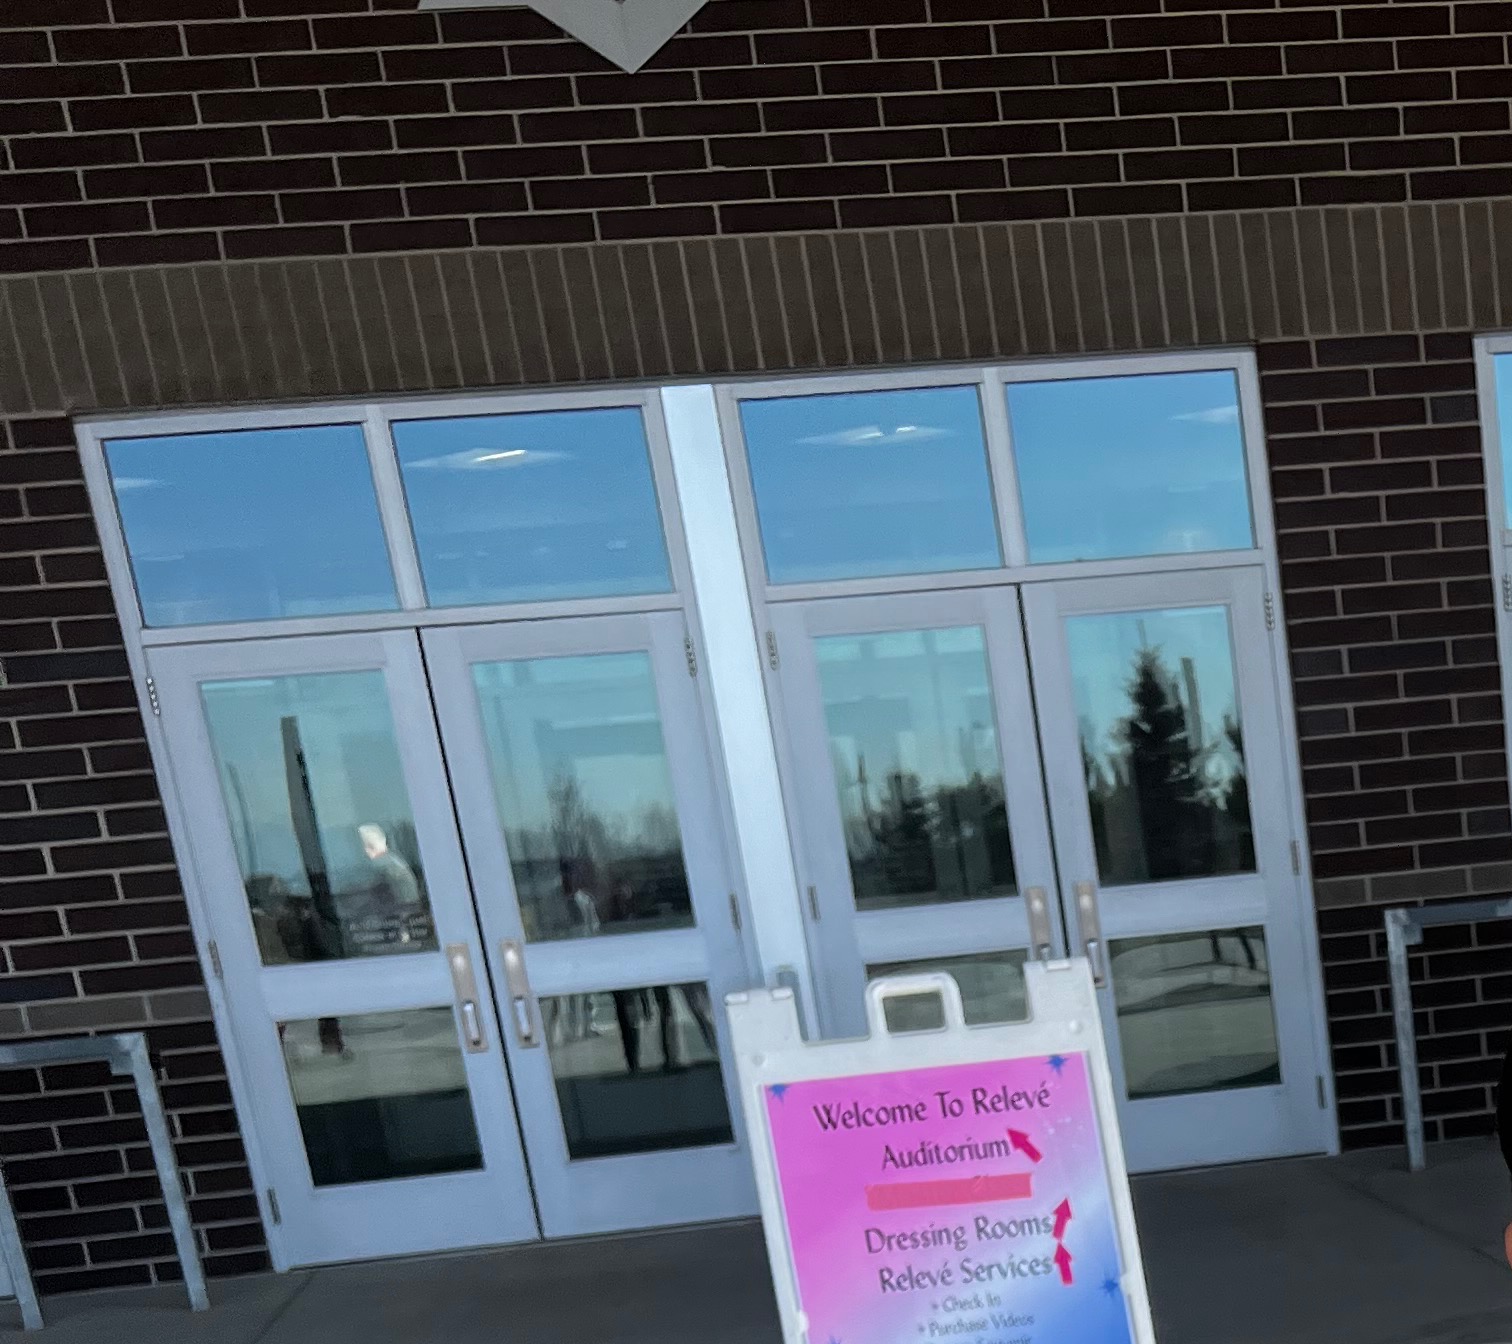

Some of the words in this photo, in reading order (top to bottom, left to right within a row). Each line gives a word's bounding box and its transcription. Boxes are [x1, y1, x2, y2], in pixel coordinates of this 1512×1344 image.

[813, 1101, 928, 1132] Welcome
[934, 1090, 964, 1119] To
[971, 1081, 1051, 1115] Relevé
[881, 1137, 1010, 1170] Auditorium
[864, 1221, 968, 1254] Dressing
[973, 1215, 1052, 1241] Rooms
[878, 1261, 953, 1294] Relevé
[959, 1254, 1053, 1284] Services
